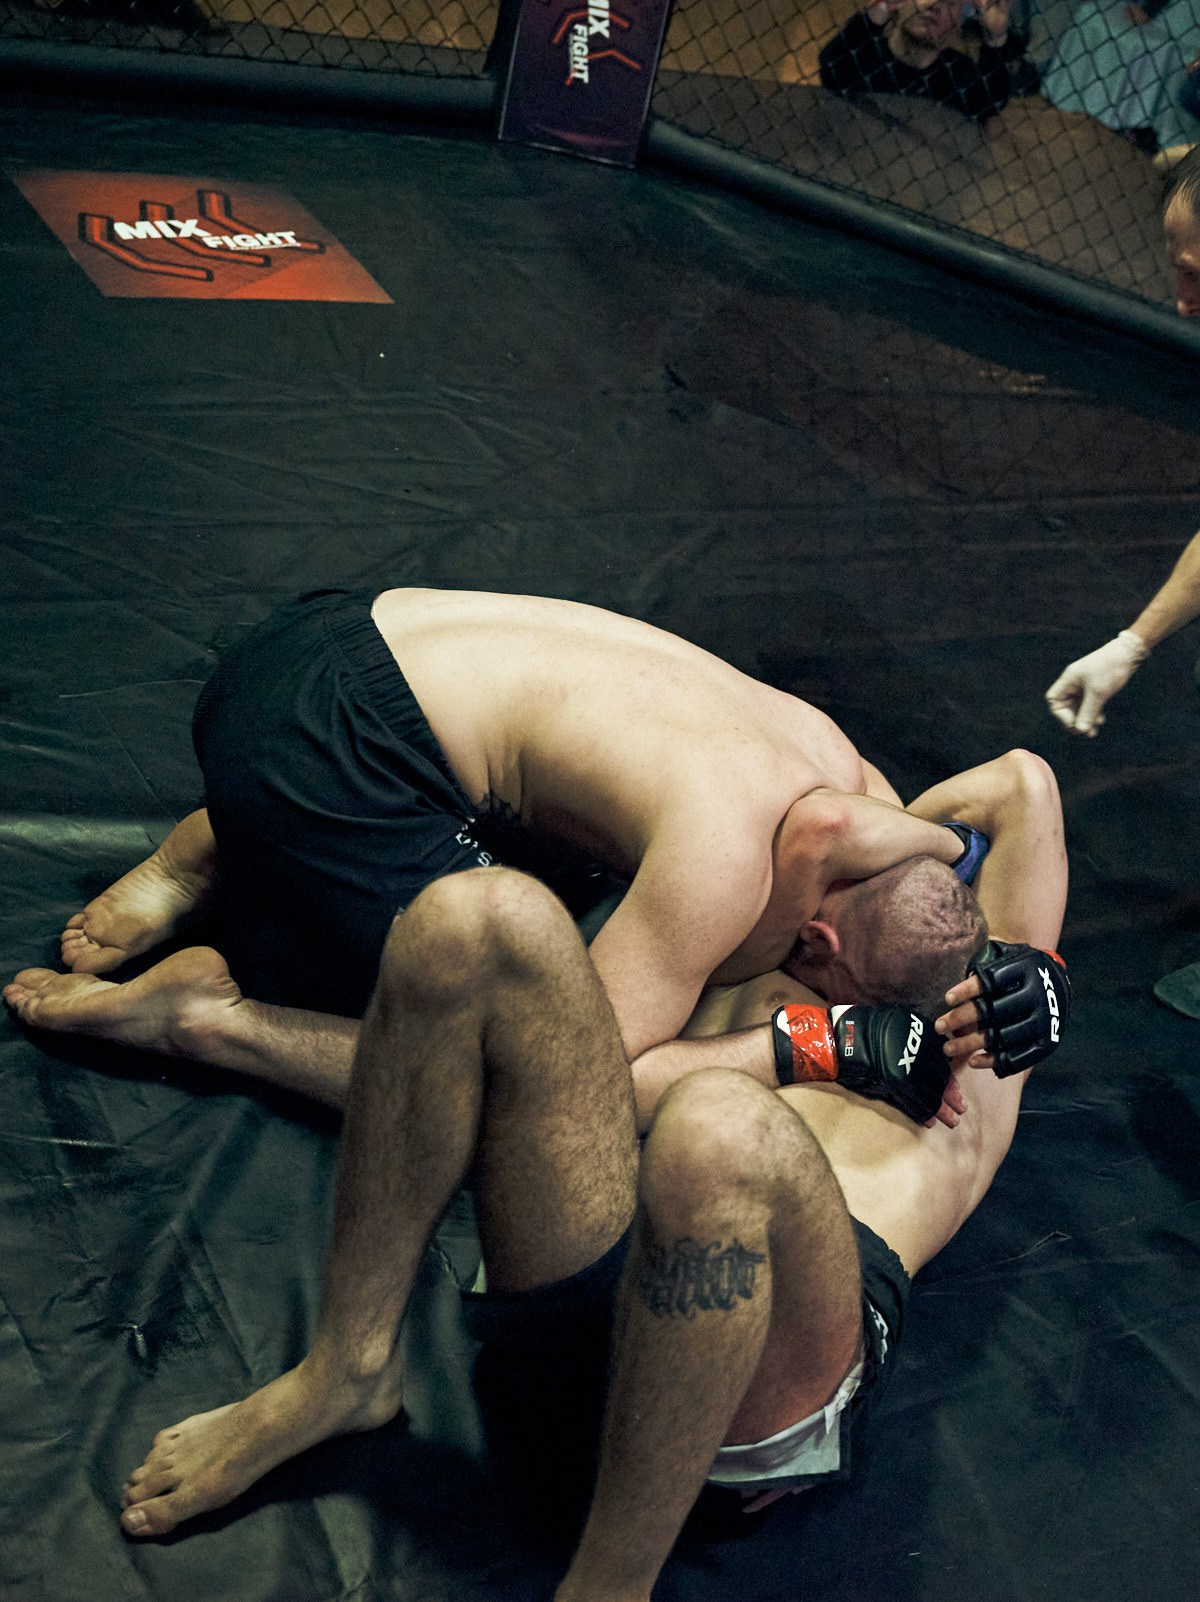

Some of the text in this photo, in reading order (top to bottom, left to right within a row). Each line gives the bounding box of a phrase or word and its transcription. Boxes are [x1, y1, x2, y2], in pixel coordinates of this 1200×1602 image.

[573, 24, 589, 84] FIGHT
[114, 219, 212, 240] MIX
[202, 231, 299, 249] FIGHT
[1037, 966, 1060, 1043] RDX
[898, 1013, 924, 1076] RDX
